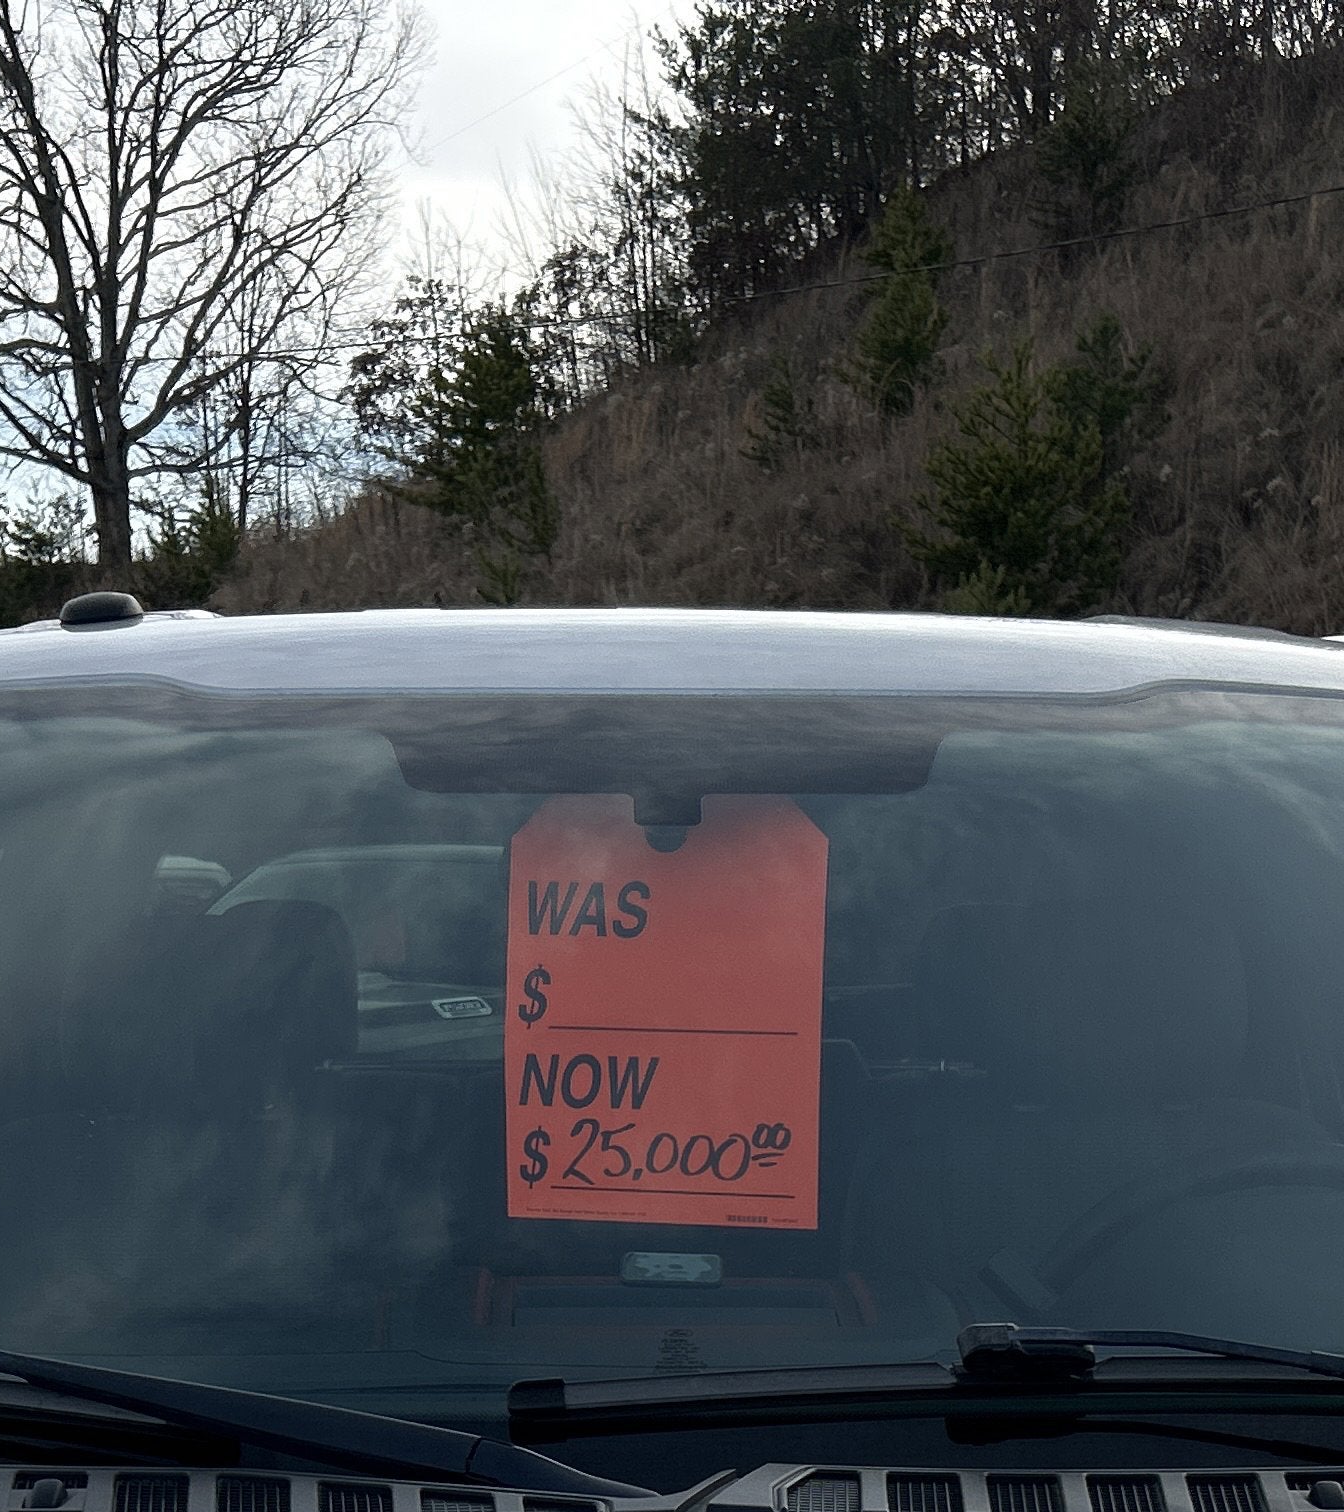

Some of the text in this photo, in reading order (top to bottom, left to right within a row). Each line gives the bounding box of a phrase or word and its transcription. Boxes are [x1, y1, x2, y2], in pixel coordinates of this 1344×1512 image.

[528, 880, 651, 938] WAS
[518, 964, 552, 1029] $
[518, 1053, 660, 1110] NOW
